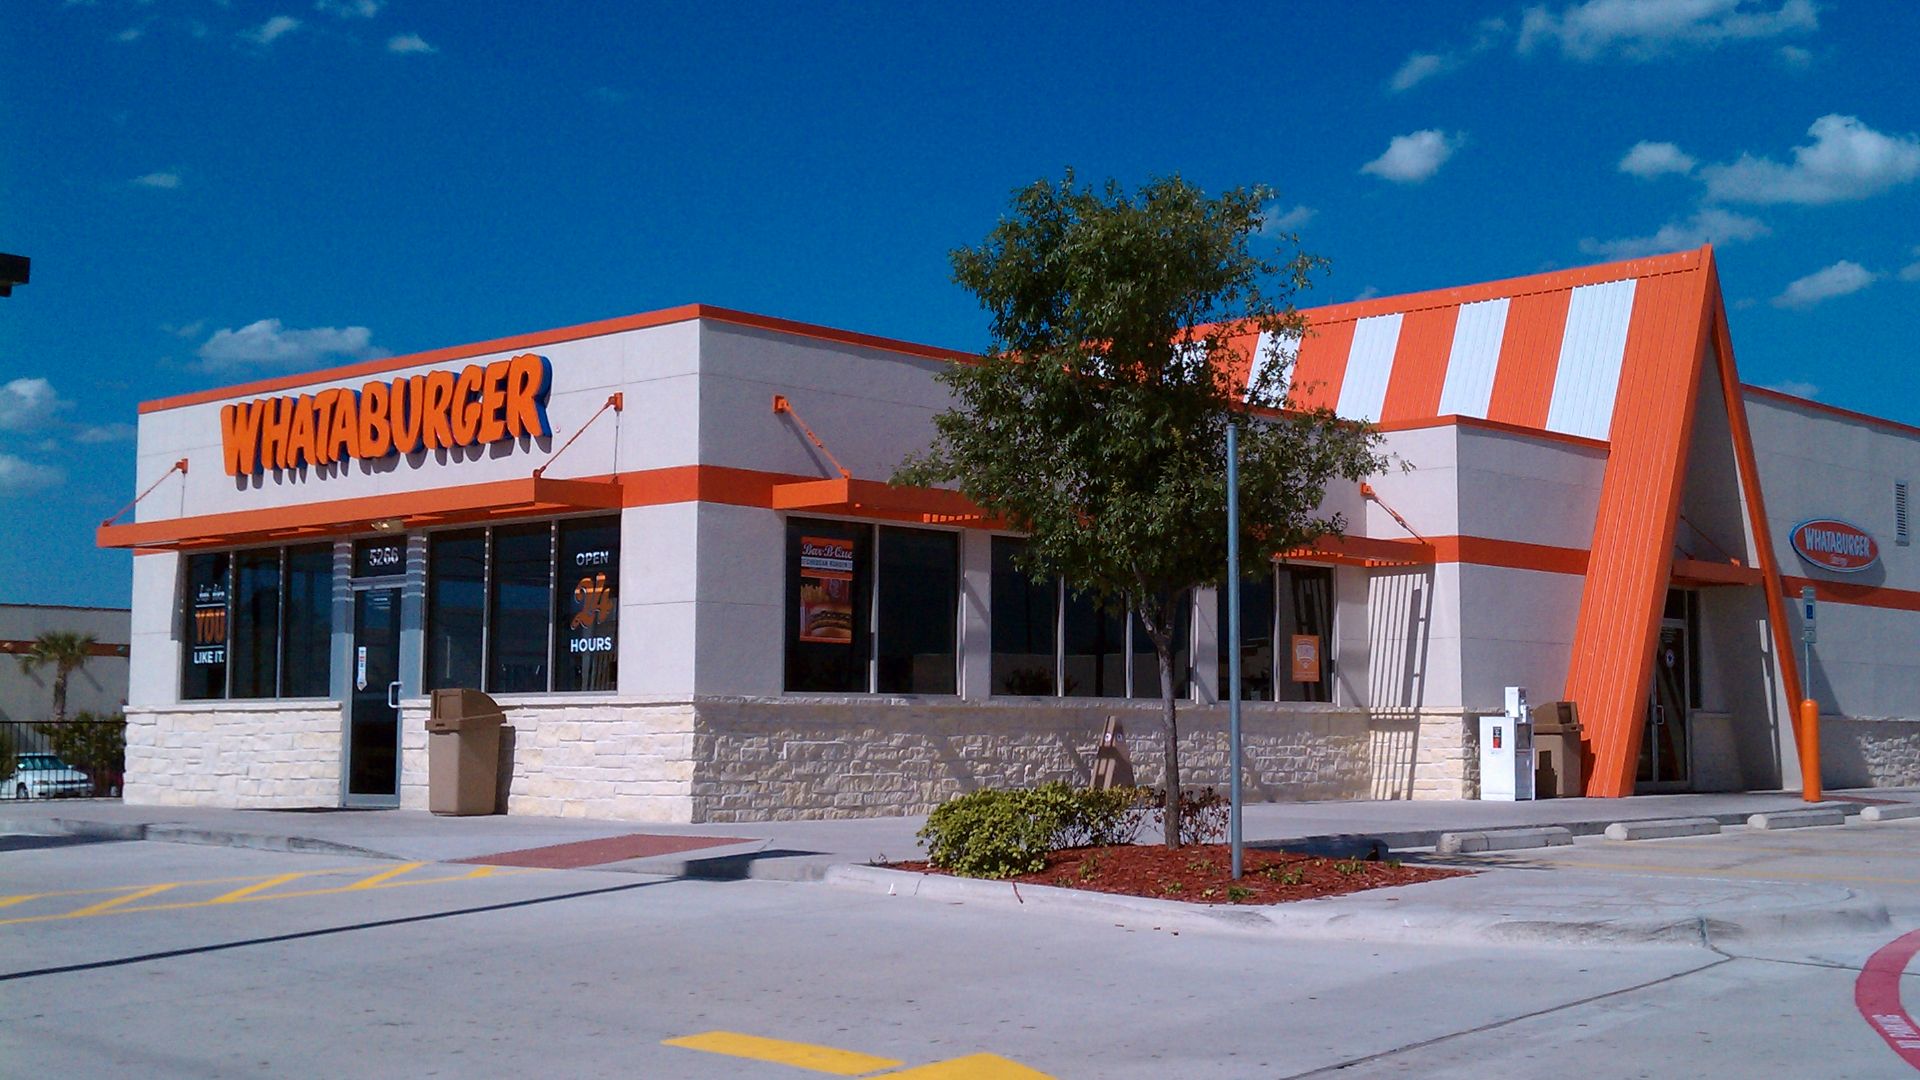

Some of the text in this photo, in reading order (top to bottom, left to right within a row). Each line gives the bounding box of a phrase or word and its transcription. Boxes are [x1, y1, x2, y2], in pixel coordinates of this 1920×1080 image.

[220, 353, 552, 476] WHATABURGER
[1804, 527, 1871, 558] WHATABURGER
[369, 547, 399, 566] 5266
[576, 551, 609, 566] OPEN
[570, 571, 613, 630] 24
[195, 610, 225, 643] YOU
[194, 651, 213, 664] LIKE
[570, 637, 612, 653] HOURS
